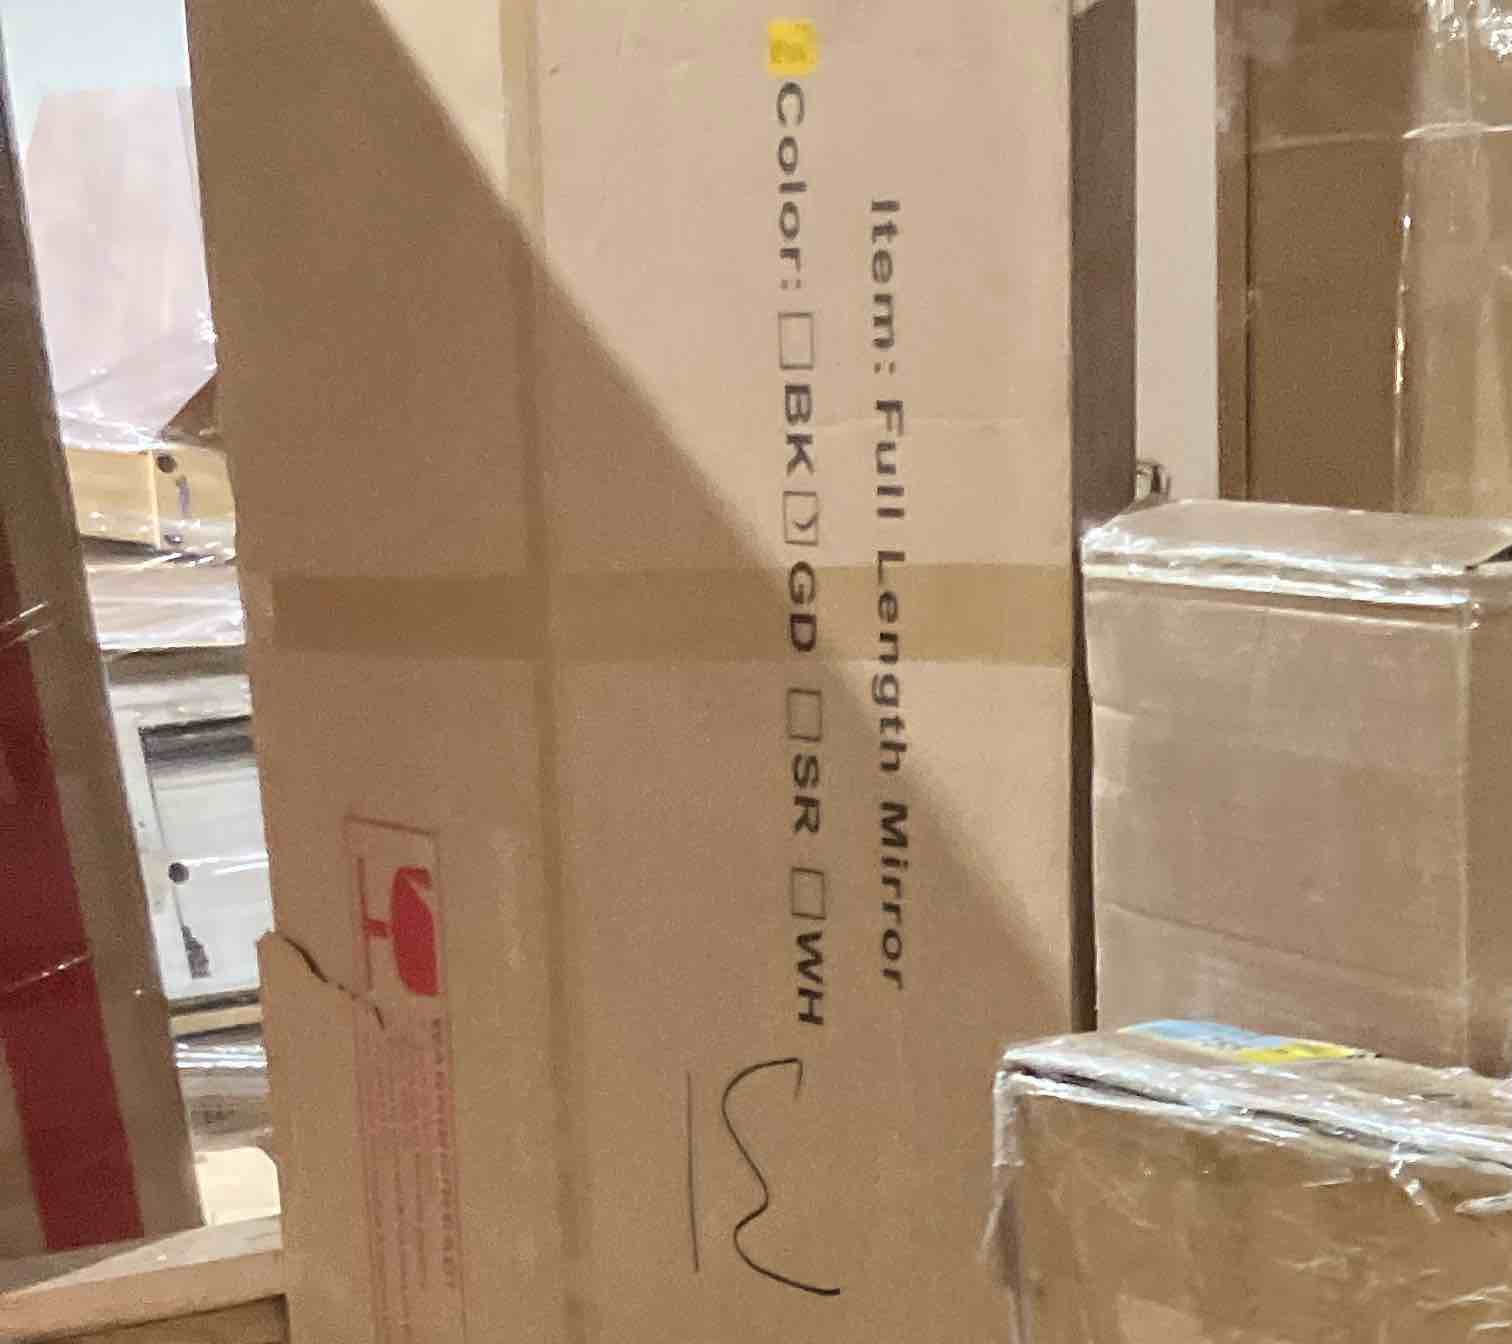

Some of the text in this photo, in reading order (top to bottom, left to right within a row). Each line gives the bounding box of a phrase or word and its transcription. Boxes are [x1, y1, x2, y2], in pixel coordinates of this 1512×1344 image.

[776, 81, 824, 1028] Color: BK GD SR WH
[870, 199, 910, 992] Item: Full Length Mirror
